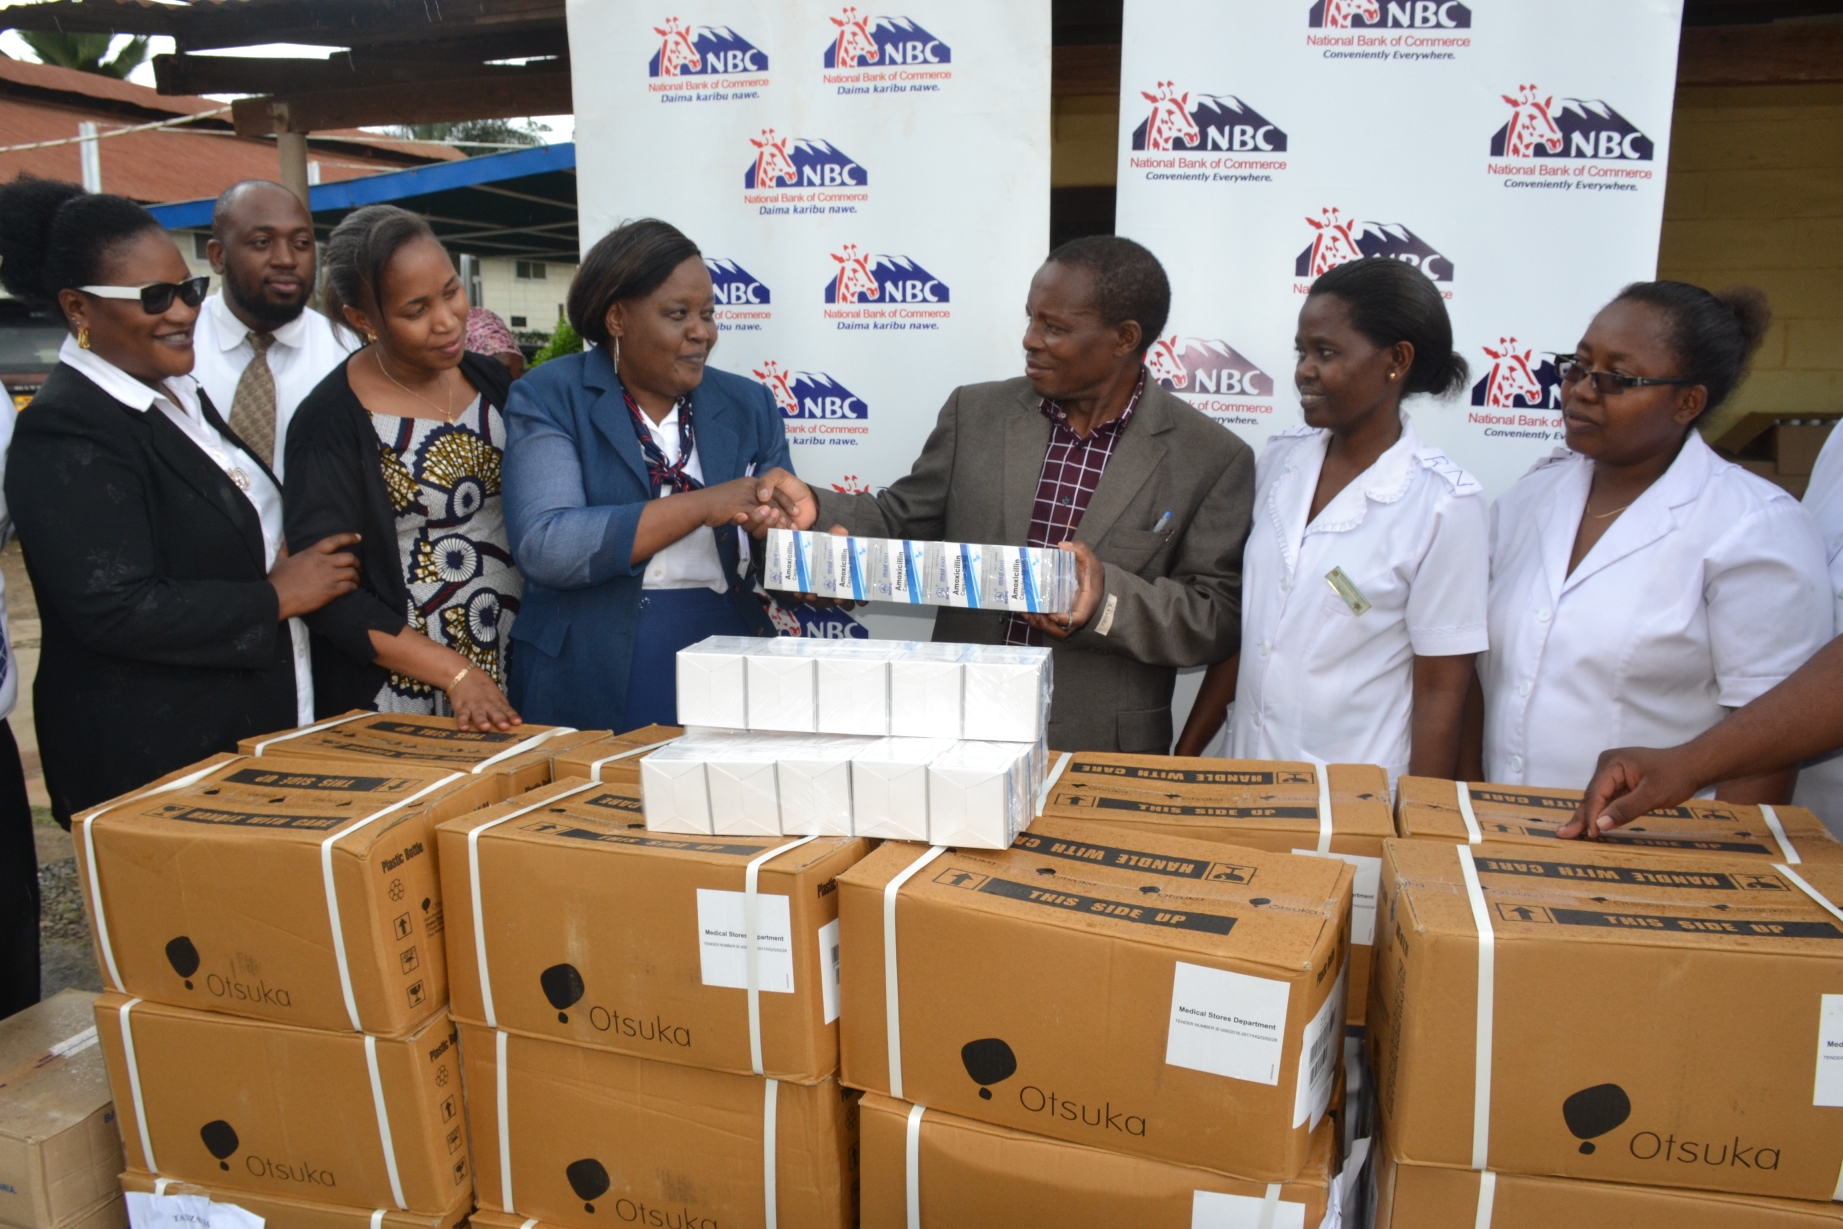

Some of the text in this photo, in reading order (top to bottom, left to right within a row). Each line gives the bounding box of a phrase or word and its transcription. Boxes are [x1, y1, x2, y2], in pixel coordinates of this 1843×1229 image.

[1387, 1, 1458, 28] NBC
[1307, 35, 1471, 48] National Bank of Commerce
[706, 48, 759, 74] NBC
[884, 40, 941, 66] NBC
[1323, 49, 1456, 61] Conveniently Everywhere.
[648, 77, 770, 93] National Bank of Commerce
[823, 70, 952, 84] National Bank of Commerce
[661, 91, 760, 104] Daima karibu nawe.
[837, 83, 940, 95] Daima karibu nawe.
[1206, 124, 1275, 152] NBC
[1570, 130, 1642, 160] NBC
[1130, 157, 1287, 170] National Bank of Commerce
[1487, 163, 1653, 180] National Bank of Commerce
[802, 163, 858, 187] NBC
[1146, 171, 1273, 183] Conveniently Everywhere.
[1504, 178, 1639, 192] Conveniently Everywhere.
[744, 191, 868, 205] National Bank of Commerce
[759, 203, 858, 215] Daima karibu nawe.
[712, 281, 762, 304] NBC
[884, 279, 940, 303] NBC
[714, 310, 771, 320] of Commerce
[823, 308, 950, 319] National Bank of Commerce
[735, 322, 763, 331] nawe.
[837, 320, 940, 330] Daima karibu nawe.
[1195, 368, 1261, 395] NBC
[803, 395, 859, 419] NBC
[1197, 400, 1208, 411] of
[1211, 400, 1274, 414] Commerce
[808, 424, 818, 434] of
[819, 424, 869, 434] Commerce
[1468, 412, 1516, 426] National
[1518, 414, 1549, 428] Bank
[793, 436, 826, 446] karibu
[829, 437, 859, 446] nawe.
[1484, 427, 1551, 441] Conveniently
[785, 541, 794, 580] Amoxicillin
[839, 548, 848, 587] Amoxicillin
[895, 551, 904, 592] Amoxicillin
[952, 555, 961, 596] Amoxicillin
[1011, 558, 1020, 600] Amoxicillin
[806, 620, 859, 640] NBC
[254, 774, 356, 788] THIS SIDE UP
[1081, 764, 1264, 784] HANDLE WITH CARE
[600, 797, 642, 809] CARE
[1481, 792, 1530, 805] CARE
[1139, 803, 1277, 817] THIS SIDE UP
[381, 842, 424, 874] Plastic Bottle
[1050, 842, 1196, 875] HANDLE WITH
[1486, 860, 1720, 886] HANDLE WITH CARE
[817, 877, 837, 899] Plastic
[1029, 890, 1187, 924] THIS SIDE UP
[1269, 903, 1319, 915] Otsuka
[704, 929, 727, 937] Medical
[1603, 914, 1786, 934] THIS SIDE UP
[206, 973, 292, 1007] Otsuka
[589, 1005, 691, 1048] Otsuka
[1175, 1018, 1195, 1027] TENDER
[1194, 1022, 1215, 1031] NUMBER
[1178, 1005, 1277, 1031] Medical Stores Department
[429, 1038, 450, 1063] Plastic
[1019, 1085, 1146, 1137] Otsuka
[1629, 1131, 1780, 1171] Otsuka
[246, 1155, 337, 1188] Otsuka
